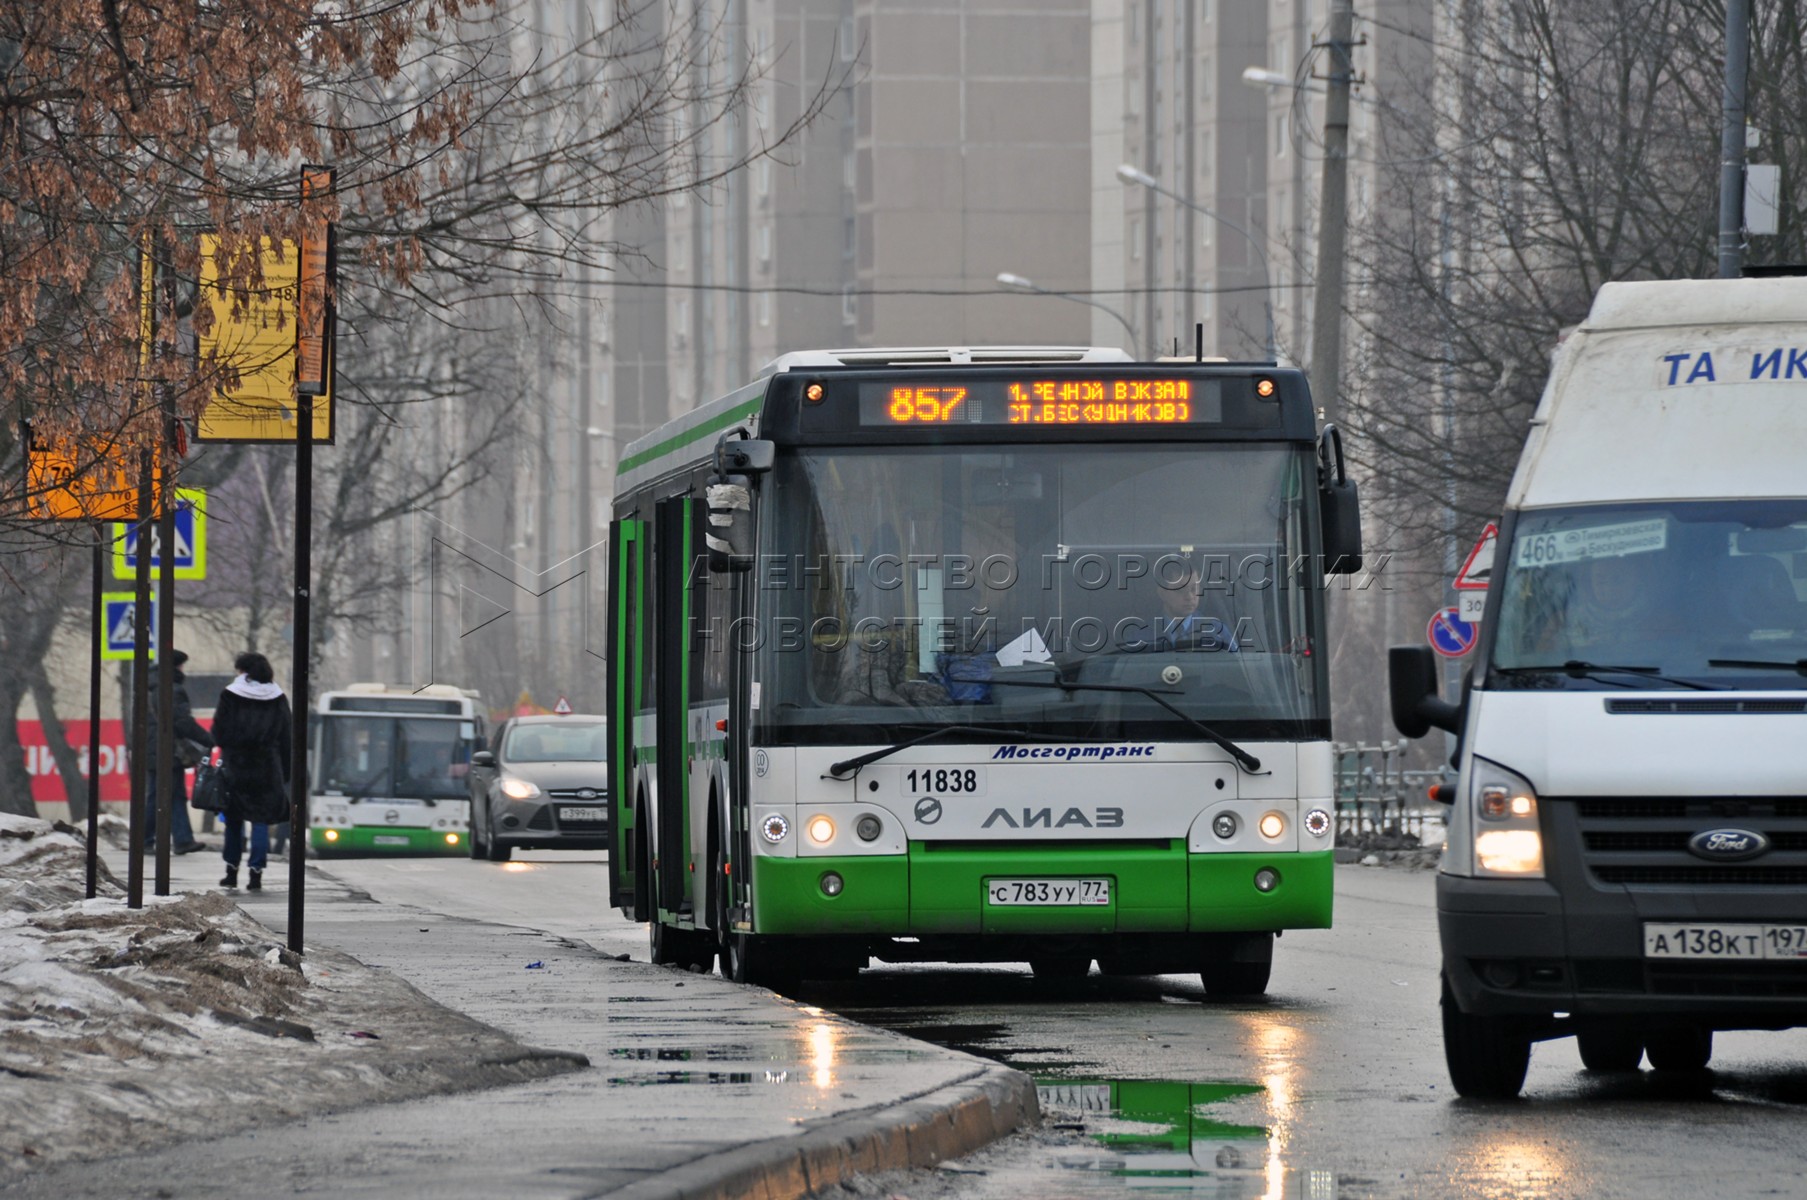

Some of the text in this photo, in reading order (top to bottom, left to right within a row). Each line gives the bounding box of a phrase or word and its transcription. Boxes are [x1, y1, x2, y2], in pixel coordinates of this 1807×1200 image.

[889, 387, 967, 422] 857
[992, 745, 1155, 761] Мосгортранс
[906, 769, 977, 793] 11838
[981, 807, 1125, 828] ЛИАЗ
[1706, 833, 1749, 850] Ford
